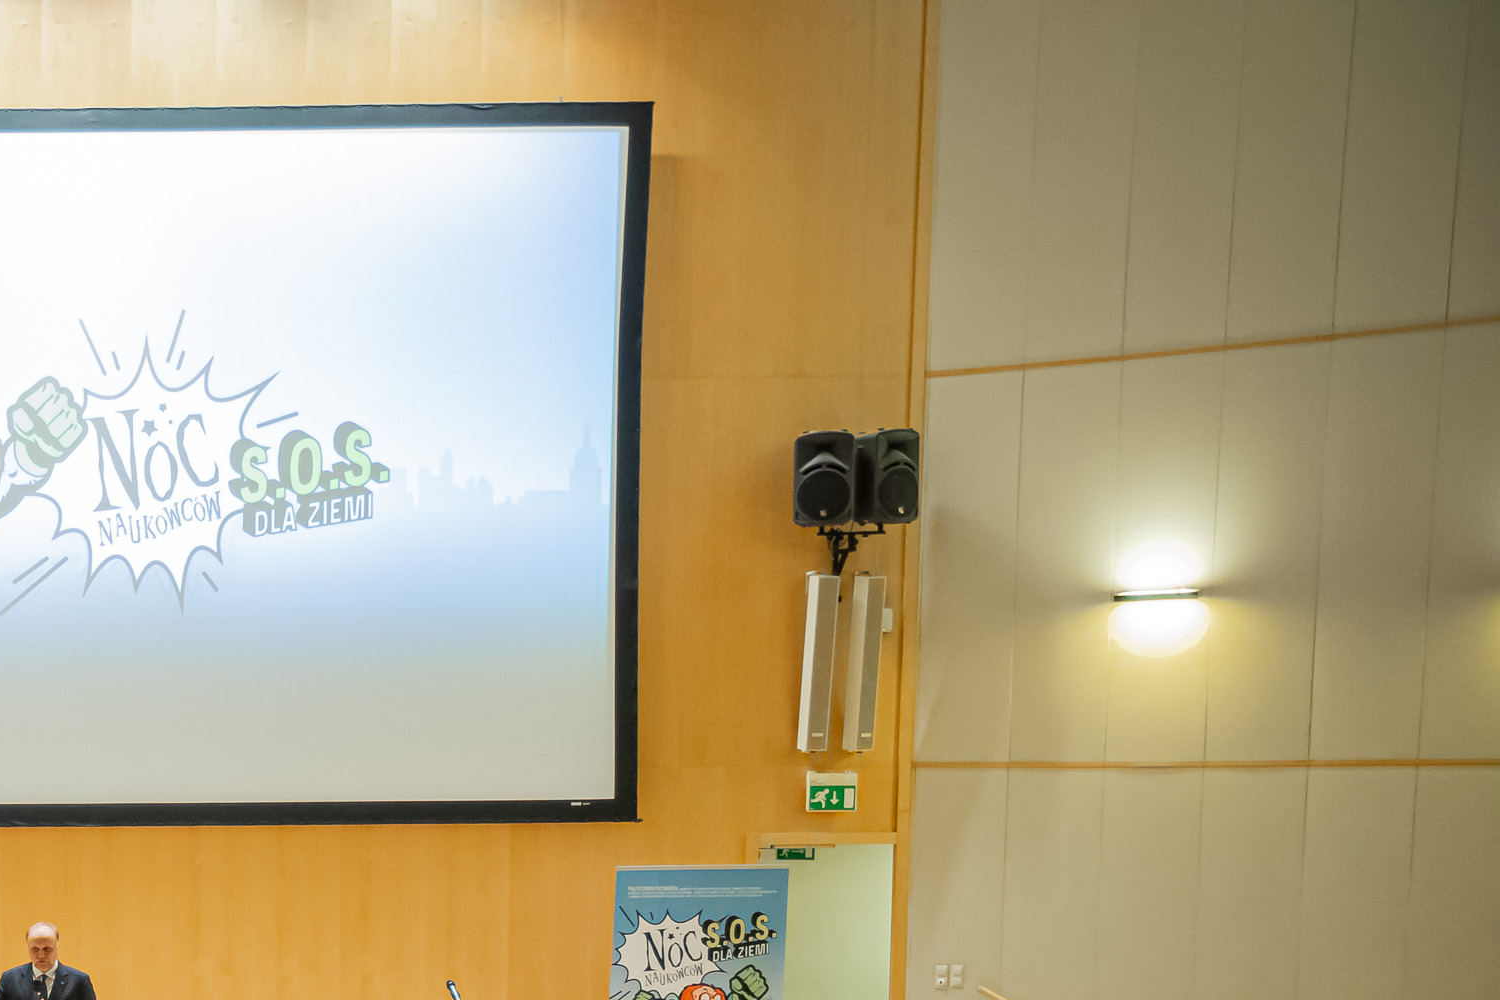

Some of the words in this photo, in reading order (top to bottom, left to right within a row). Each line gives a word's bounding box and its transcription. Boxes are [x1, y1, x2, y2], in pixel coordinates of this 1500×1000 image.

[236, 426, 389, 503] S.O.S.
[97, 490, 222, 546] NAUKOWCÓW
[254, 506, 297, 536] DLA
[307, 493, 372, 527] ZIEMI
[704, 913, 777, 948] S.O.S.
[712, 948, 732, 962] DLA
[738, 942, 769, 958] ZIEMI
